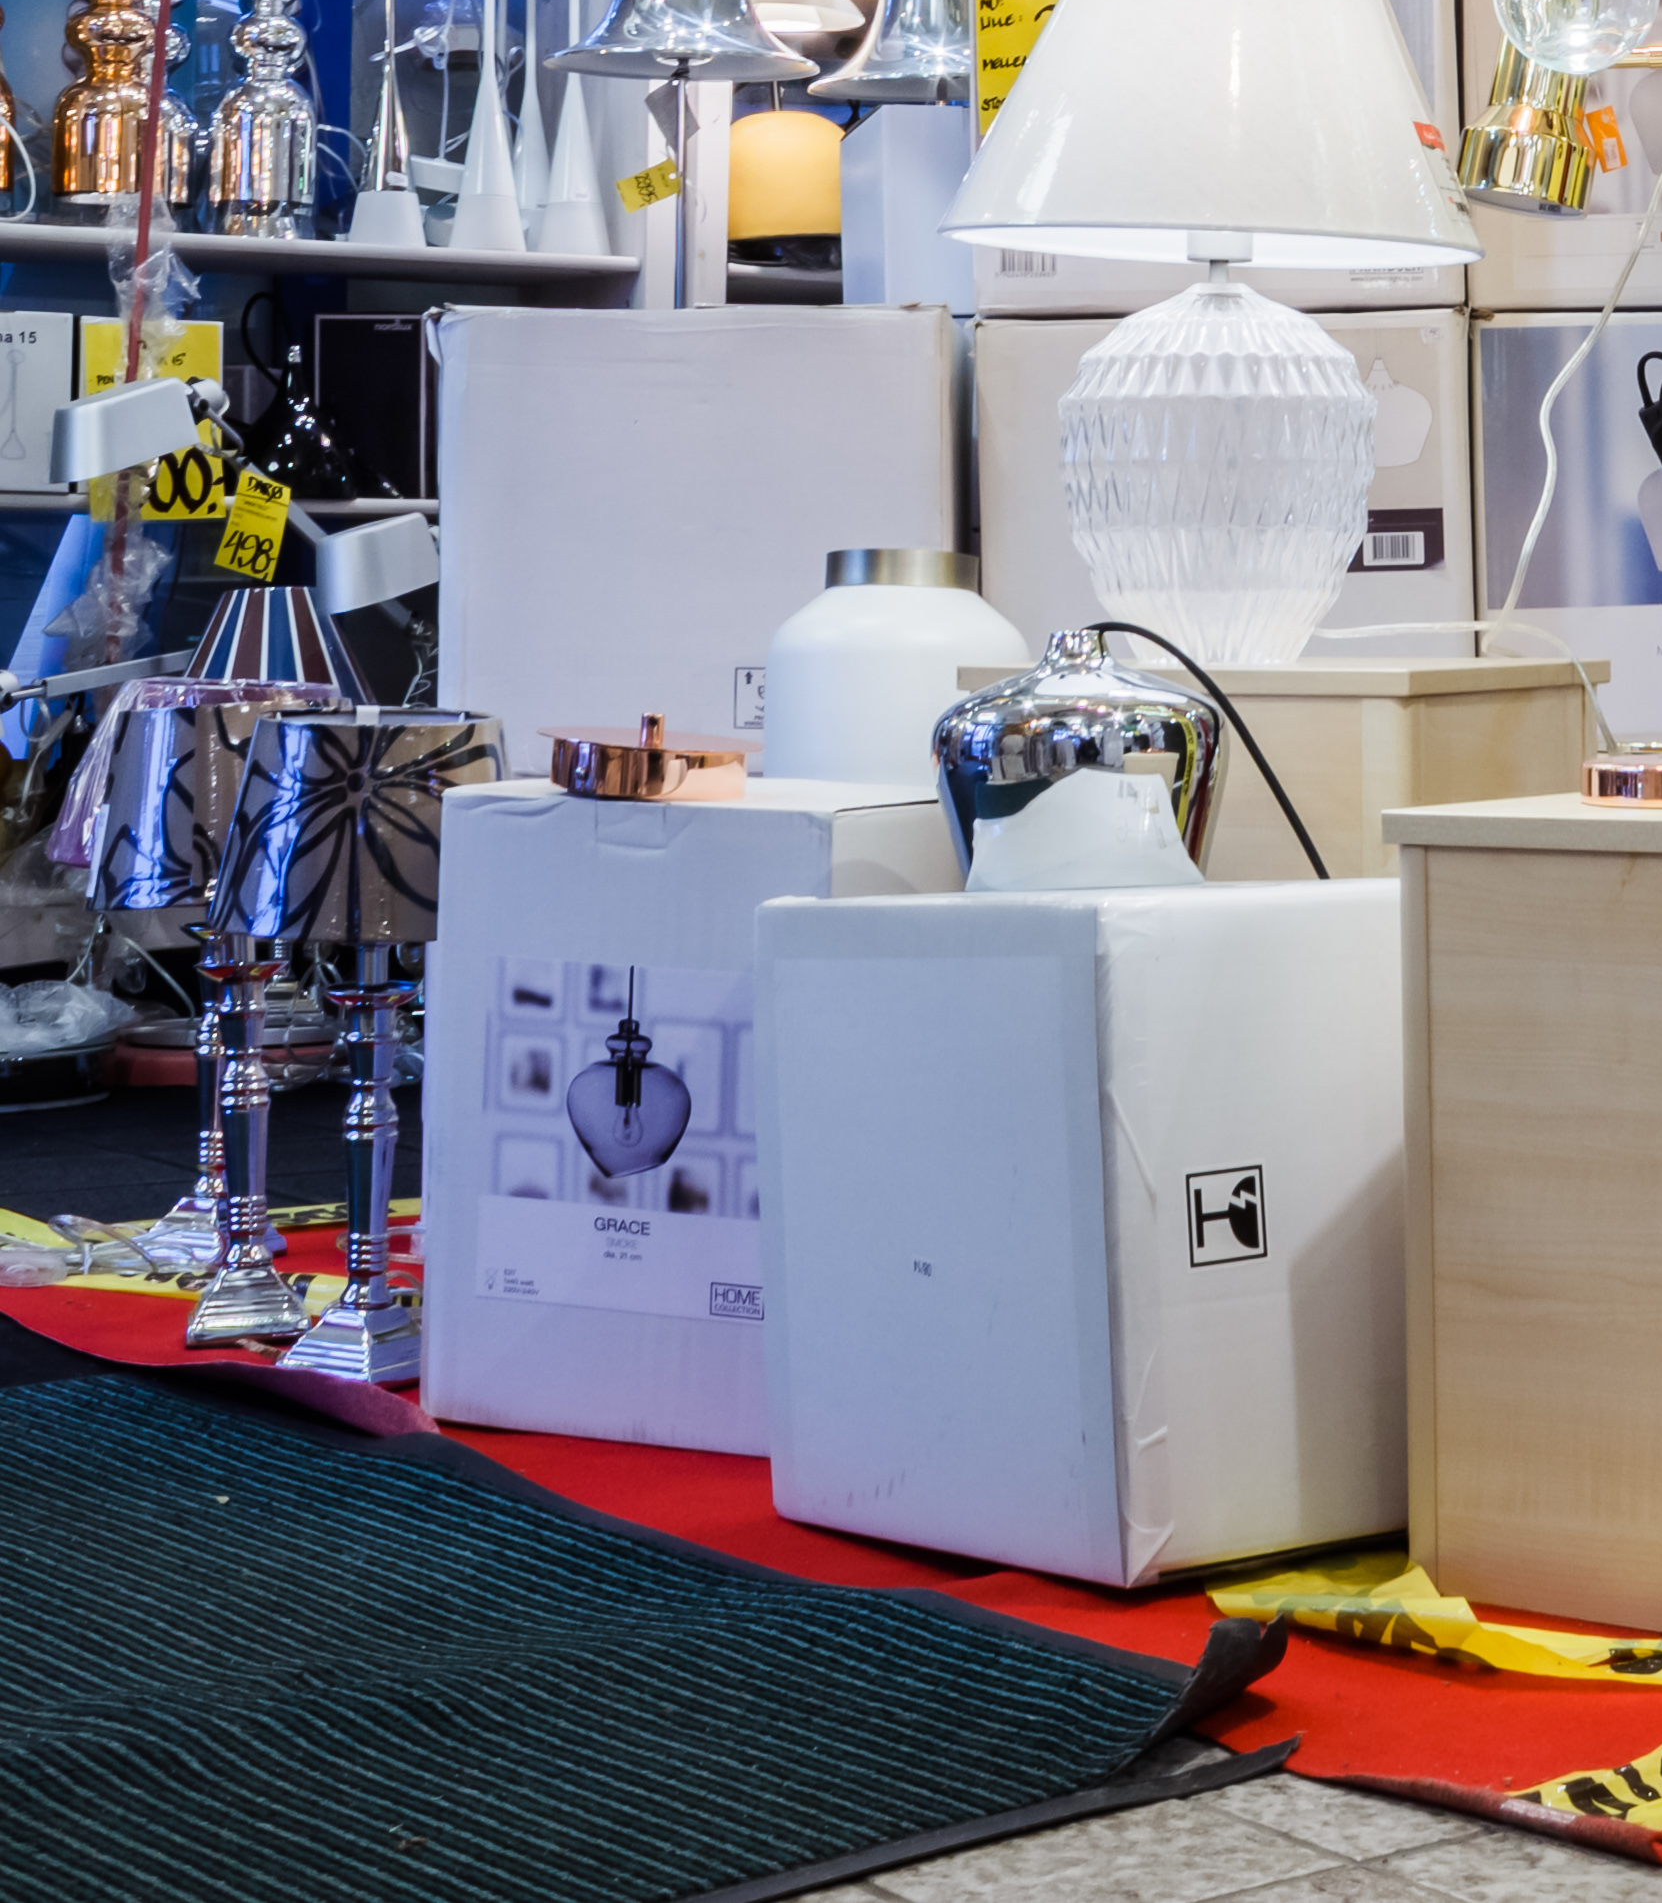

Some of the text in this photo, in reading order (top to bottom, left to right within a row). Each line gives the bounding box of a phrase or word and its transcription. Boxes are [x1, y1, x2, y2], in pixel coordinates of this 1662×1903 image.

[374, 321, 412, 332] nordlux
[19, 330, 37, 344] 15
[594, 1216, 651, 1236] GRACE
[714, 1287, 761, 1306] HOME
[714, 1304, 761, 1316] COLLECTION
